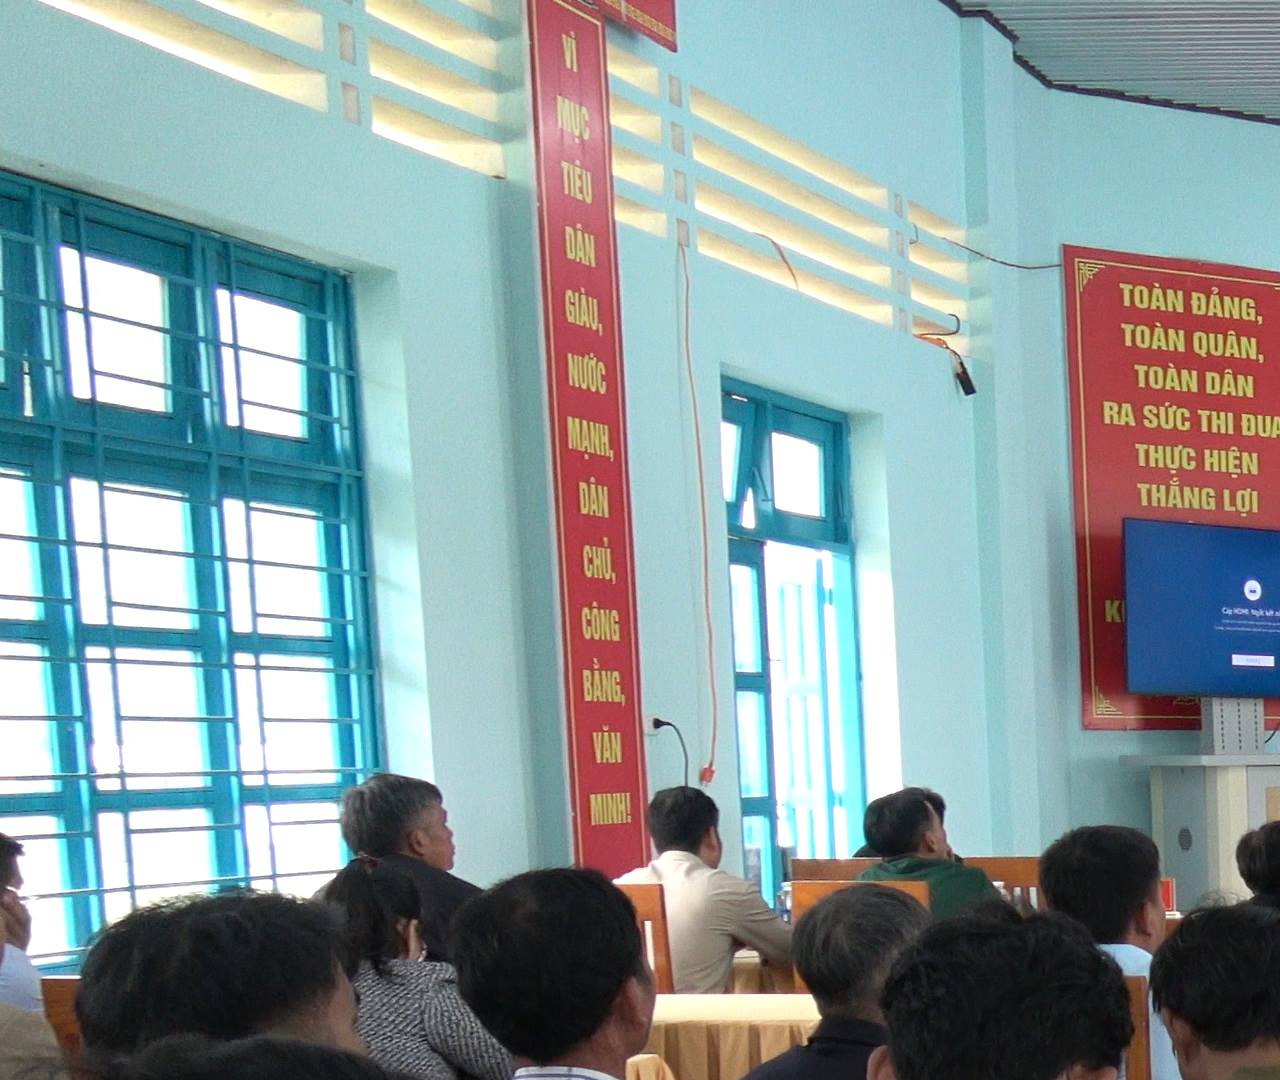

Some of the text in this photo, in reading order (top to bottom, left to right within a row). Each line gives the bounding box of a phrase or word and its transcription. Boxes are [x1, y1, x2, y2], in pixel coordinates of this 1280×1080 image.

[562, 32, 577, 72] VÌ
[556, 95, 591, 143] MỤC
[561, 160, 592, 203] TIÊU
[565, 224, 595, 267] DÂN
[565, 288, 602, 336] GIÀU,
[1120, 283, 1262, 324] TOÀN ĐẢNG,
[1121, 322, 1263, 363] TOÀN QUÂN,
[568, 353, 606, 394] NƯỚC
[1135, 363, 1253, 397] TOÀN DÂN
[567, 416, 613, 461] MẠNH,
[1104, 402, 1136, 426] RA
[1144, 402, 1190, 430] SỨC
[1198, 410, 1234, 434] THI
[1135, 444, 1258, 478] THỰC HIỆN
[579, 477, 609, 518] DÂN
[1137, 478, 1258, 517] THẮNG LỢI
[583, 537, 615, 584] CHỦ,
[582, 602, 620, 641] CÔNG
[583, 658, 625, 705] BẰNG,
[593, 726, 621, 763] VĂN
[590, 793, 631, 825] MINH!
